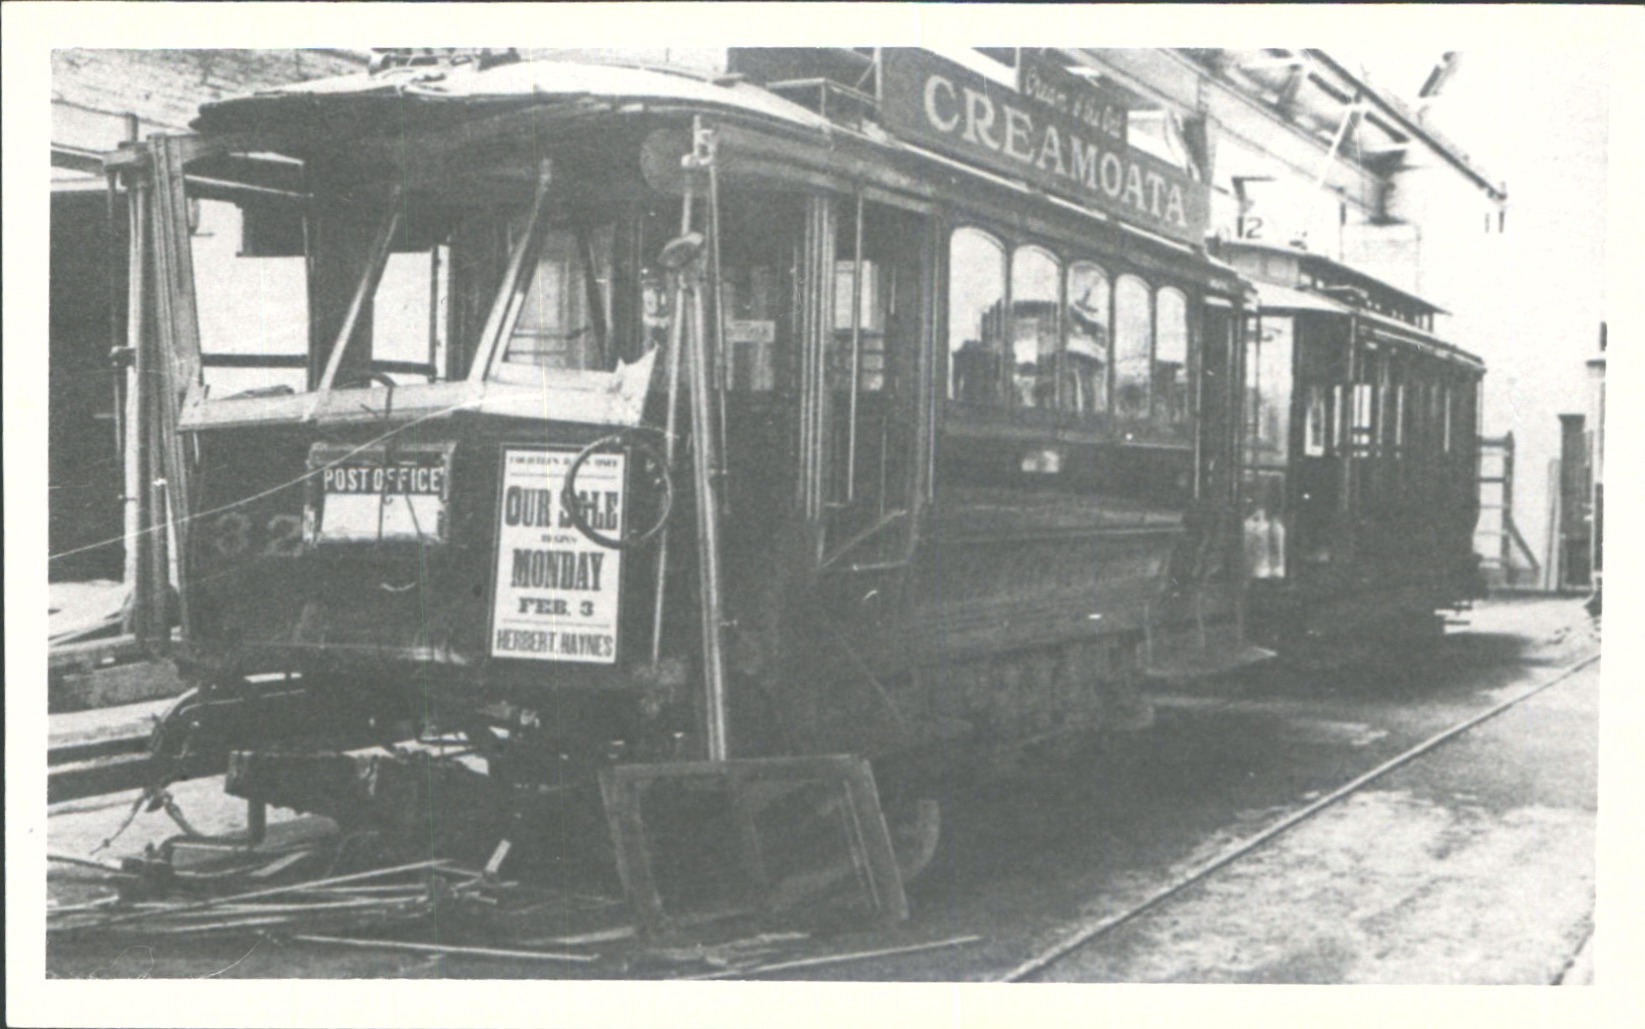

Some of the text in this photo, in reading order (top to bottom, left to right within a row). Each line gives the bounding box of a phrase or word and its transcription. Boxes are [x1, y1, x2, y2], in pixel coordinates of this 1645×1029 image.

[923, 74, 1188, 228] CREAMOATA
[323, 466, 370, 492] POST
[505, 485, 552, 528] OUR
[510, 548, 605, 592] MONDAY
[518, 596, 594, 617] FEB. 3
